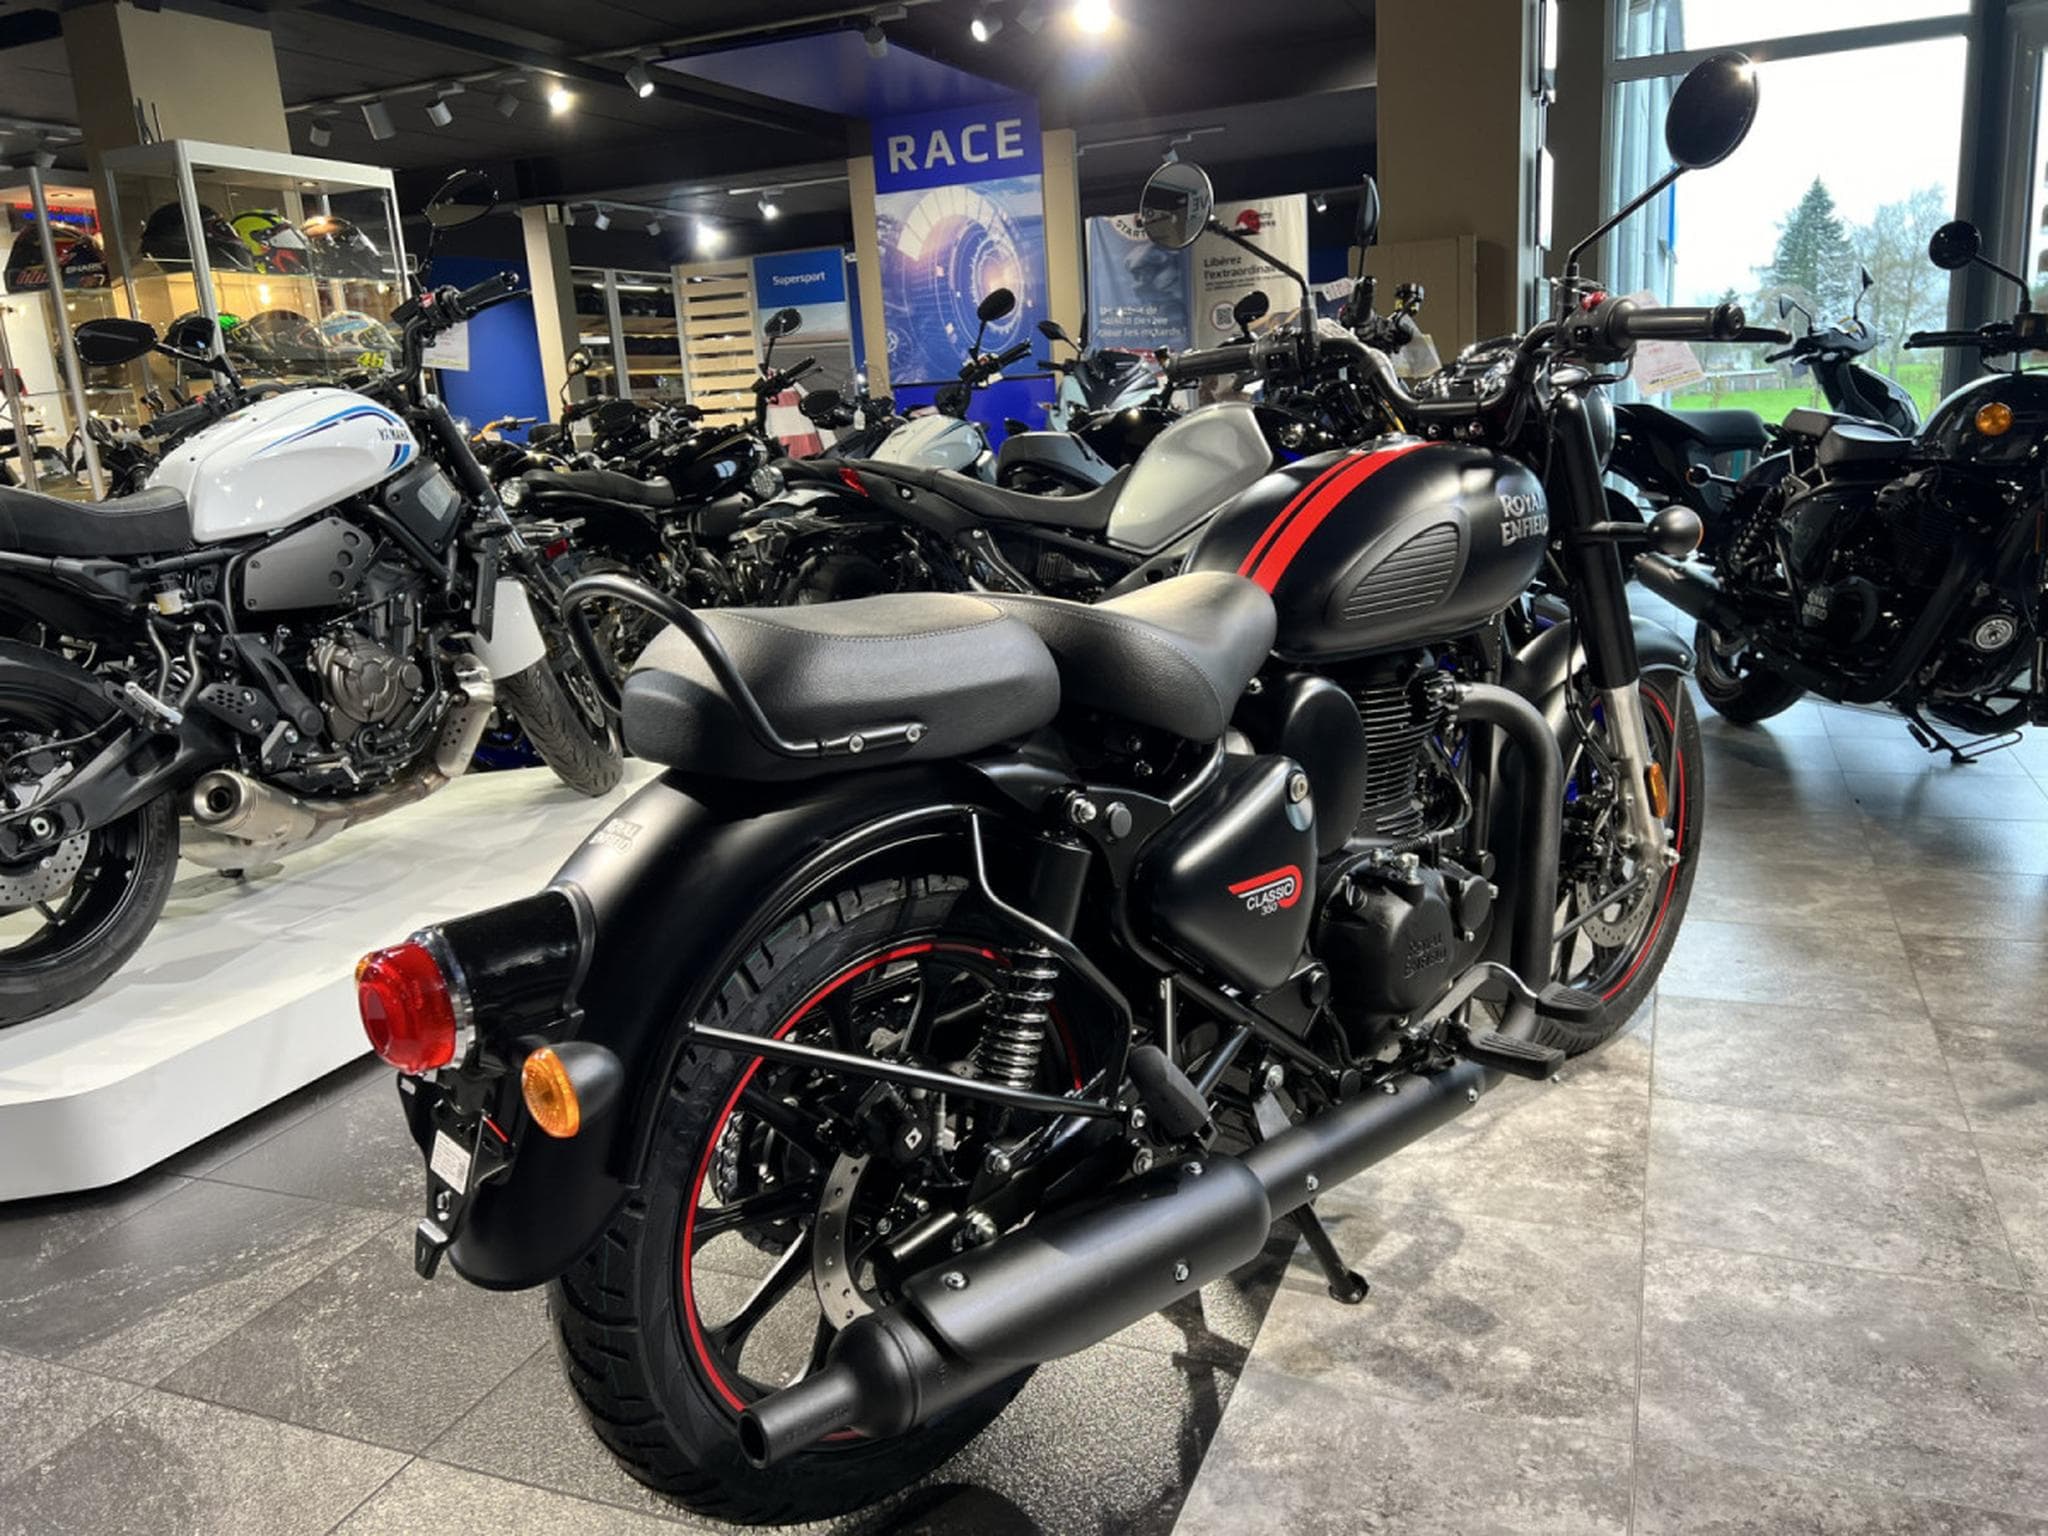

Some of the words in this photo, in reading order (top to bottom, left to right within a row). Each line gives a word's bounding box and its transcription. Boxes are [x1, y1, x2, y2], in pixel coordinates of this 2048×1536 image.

[888, 118, 1024, 174] RACE
[1203, 256, 1242, 268] Libérez
[1203, 264, 1277, 280] l'extraordinai
[772, 271, 826, 287] Supersport
[1501, 513, 1549, 547] ENFIELD
[1246, 880, 1295, 911] CLASSIC
